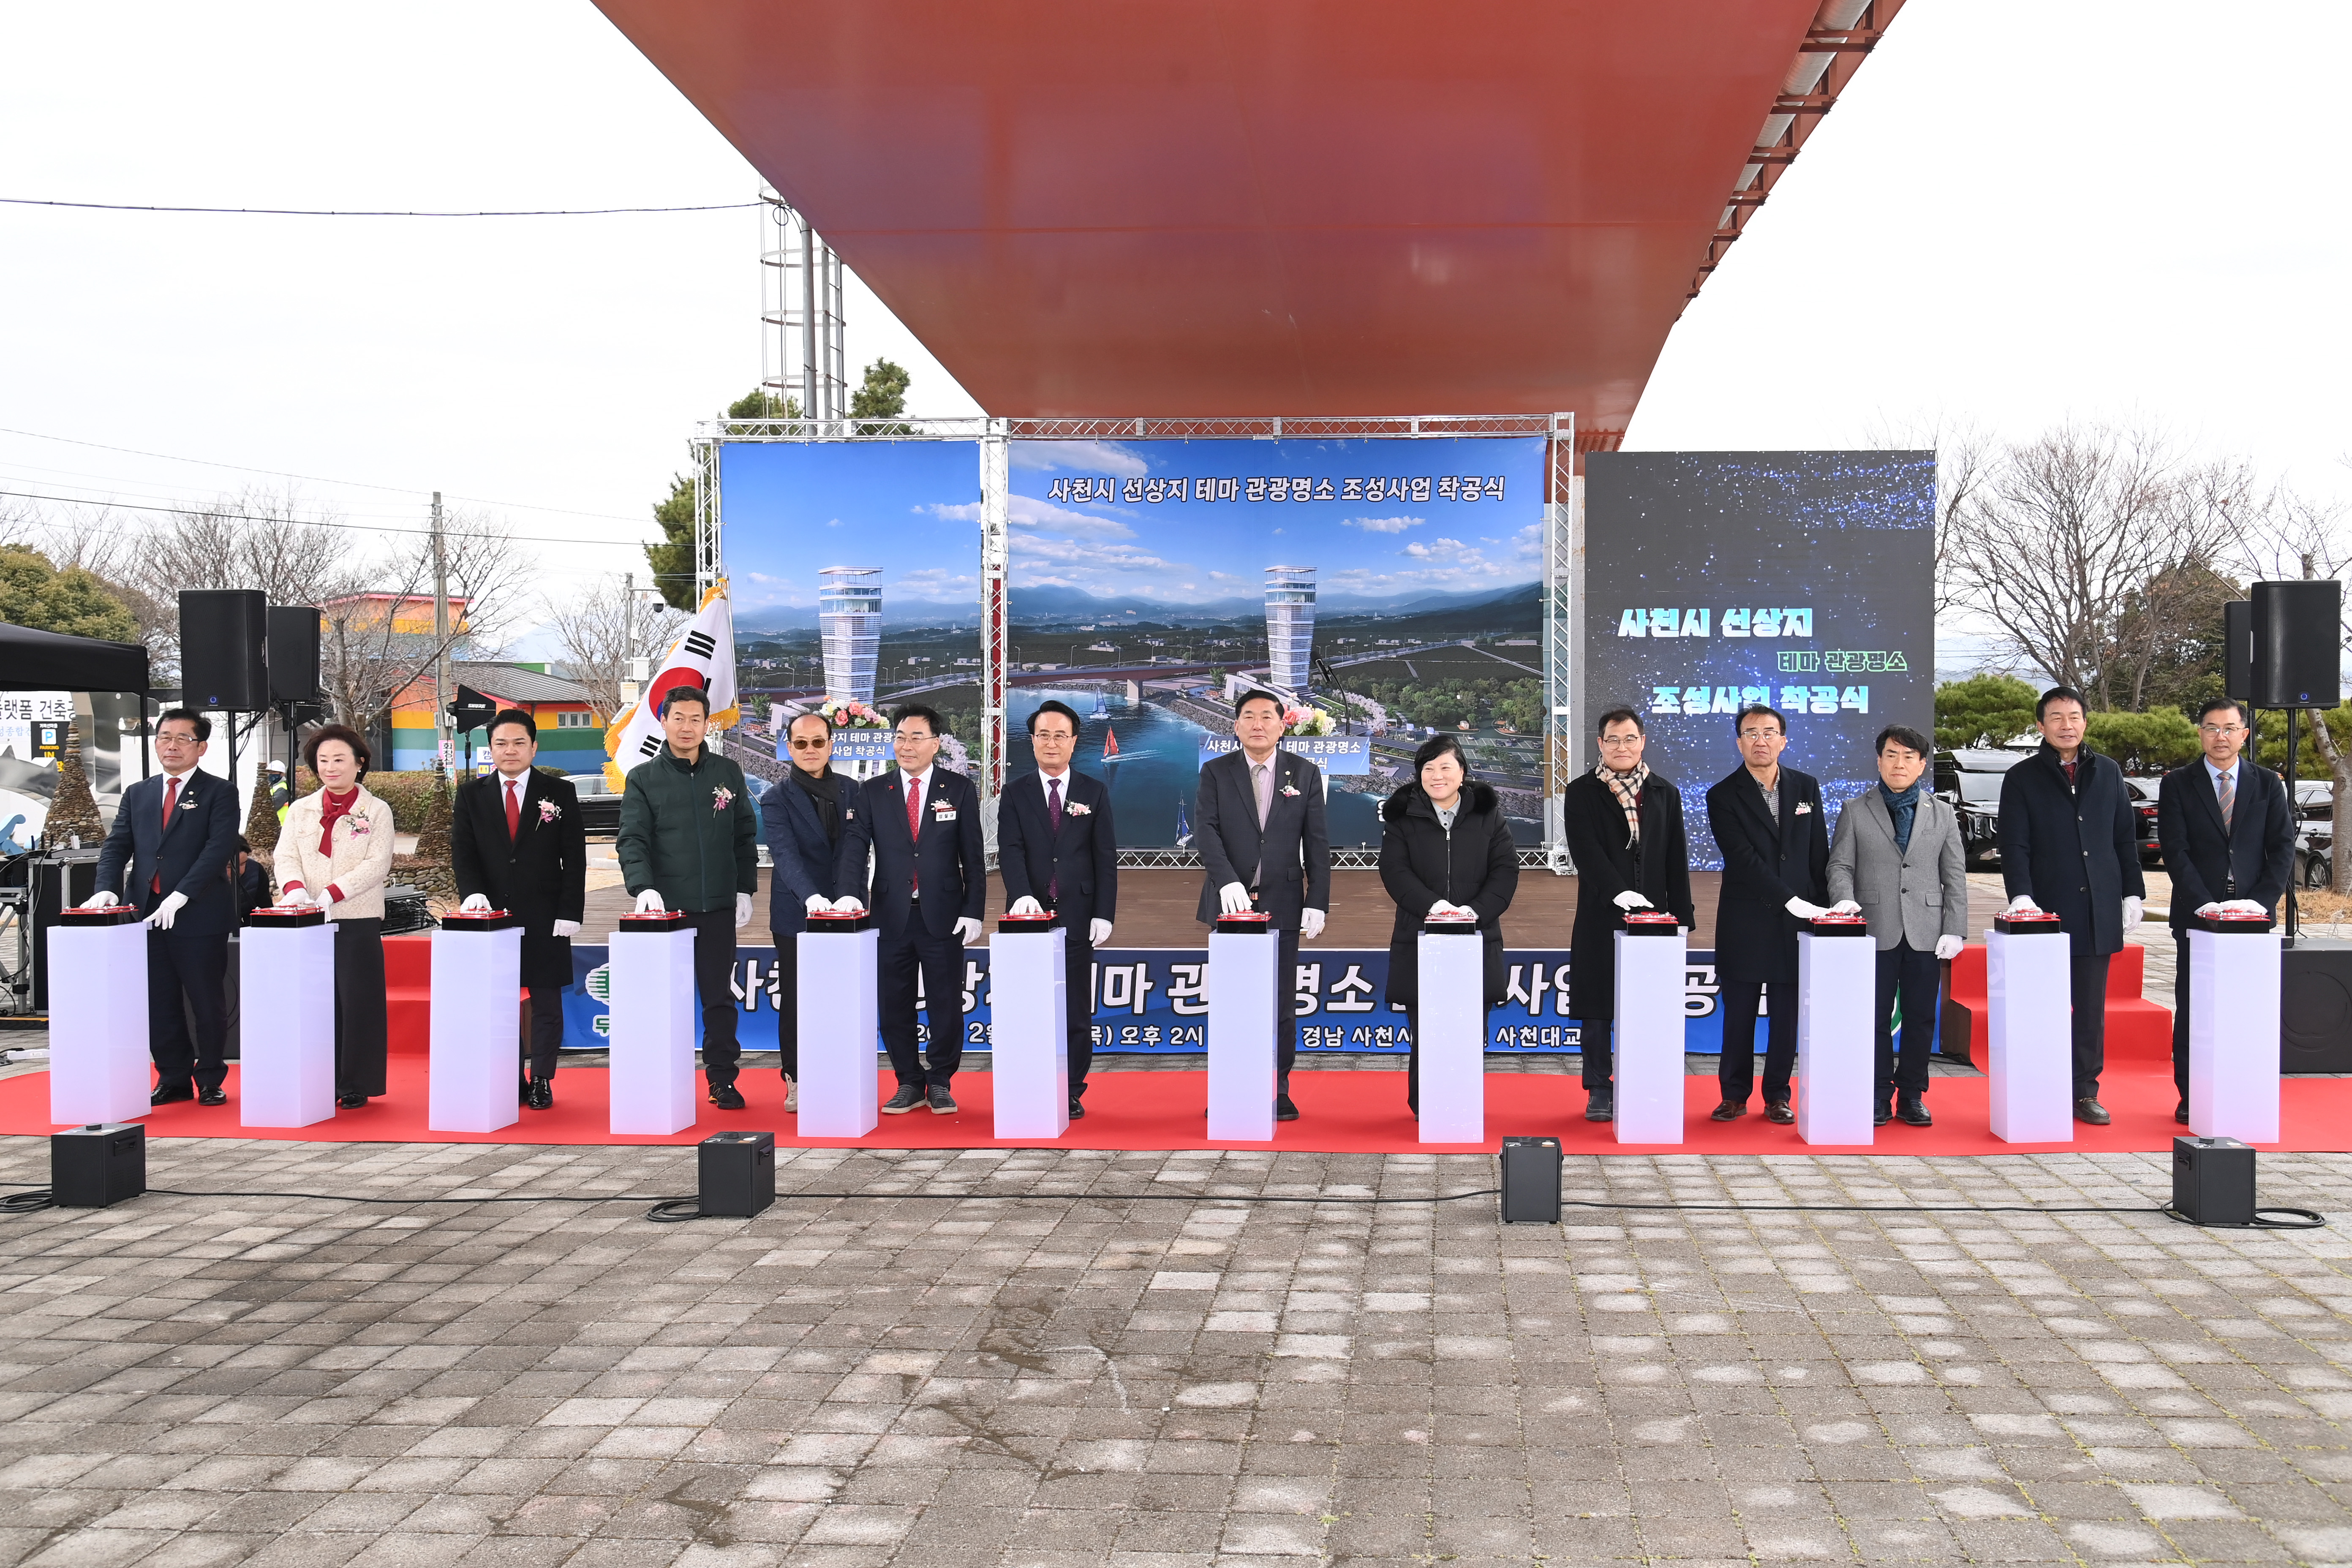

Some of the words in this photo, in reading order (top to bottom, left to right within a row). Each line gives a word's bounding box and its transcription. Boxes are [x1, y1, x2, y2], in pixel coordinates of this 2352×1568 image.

[1048, 477, 1115, 503] 사천시
[1122, 477, 1188, 503] 선상지
[1195, 477, 1240, 502] 테마
[1245, 476, 1335, 502] 관광명소
[1341, 476, 1432, 502] 조성사업
[1438, 476, 1505, 501] 착공식
[1617, 608, 1710, 637] 사천시
[1720, 608, 1813, 637] 선상지
[1776, 651, 1820, 672] 테마
[1824, 651, 1908, 672] 관광명소
[1651, 686, 1769, 714] 조성사업
[1779, 686, 1869, 714] 착공식
[45, 731, 53, 742] P
[850, 732, 871, 743] 테마
[872, 732, 896, 743] 관광
[1207, 740, 1243, 753] 사천시
[1286, 741, 1310, 754] 테마
[1313, 740, 1361, 754] 관광명소
[855, 746, 886, 757] 착공식
[1120, 1025, 1161, 1046] 오후
[1170, 1026, 1203, 1046] 2시
[1302, 1026, 1344, 1047] 경남
[1496, 1026, 1581, 1046] 사천대교
